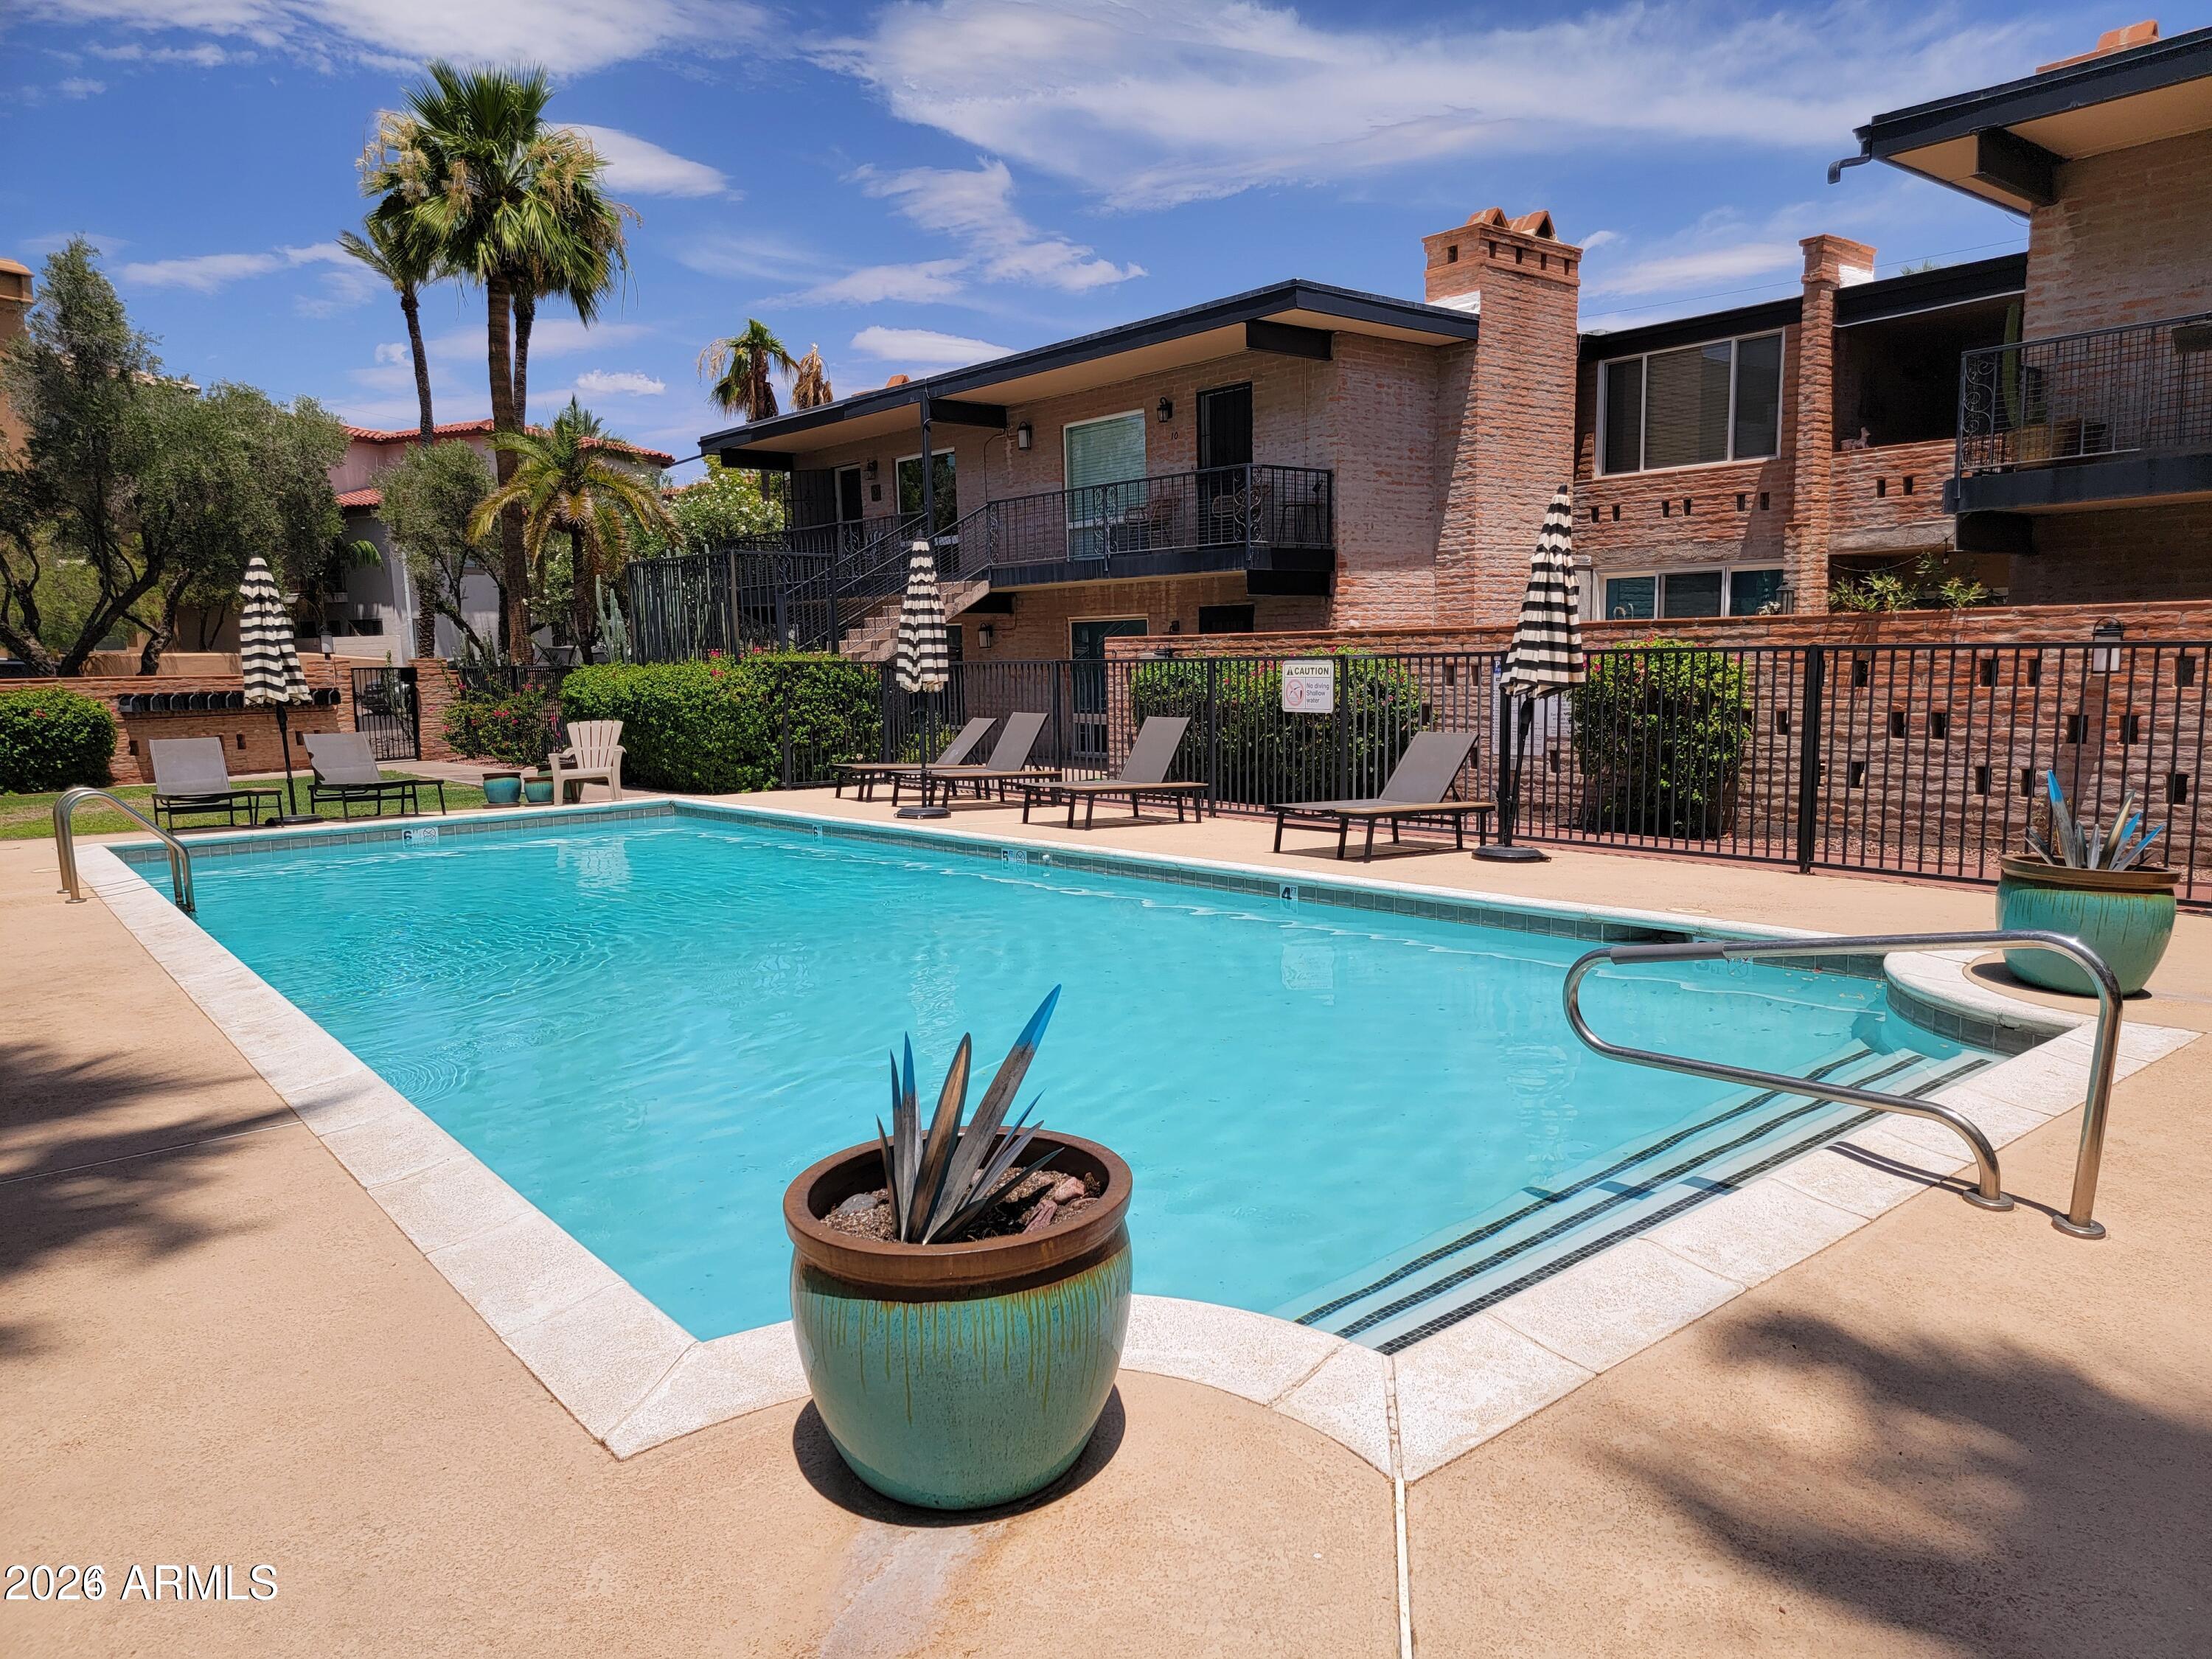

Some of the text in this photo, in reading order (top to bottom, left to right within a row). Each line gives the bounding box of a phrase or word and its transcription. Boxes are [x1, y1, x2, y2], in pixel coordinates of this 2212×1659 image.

[1171, 431, 1178, 439] 10
[1294, 667, 1329, 675] CAUTION
[403, 830, 412, 839] 6
[814, 827, 818, 837] 6
[1003, 850, 1009, 861] 5
[1281, 887, 1292, 900] 4
